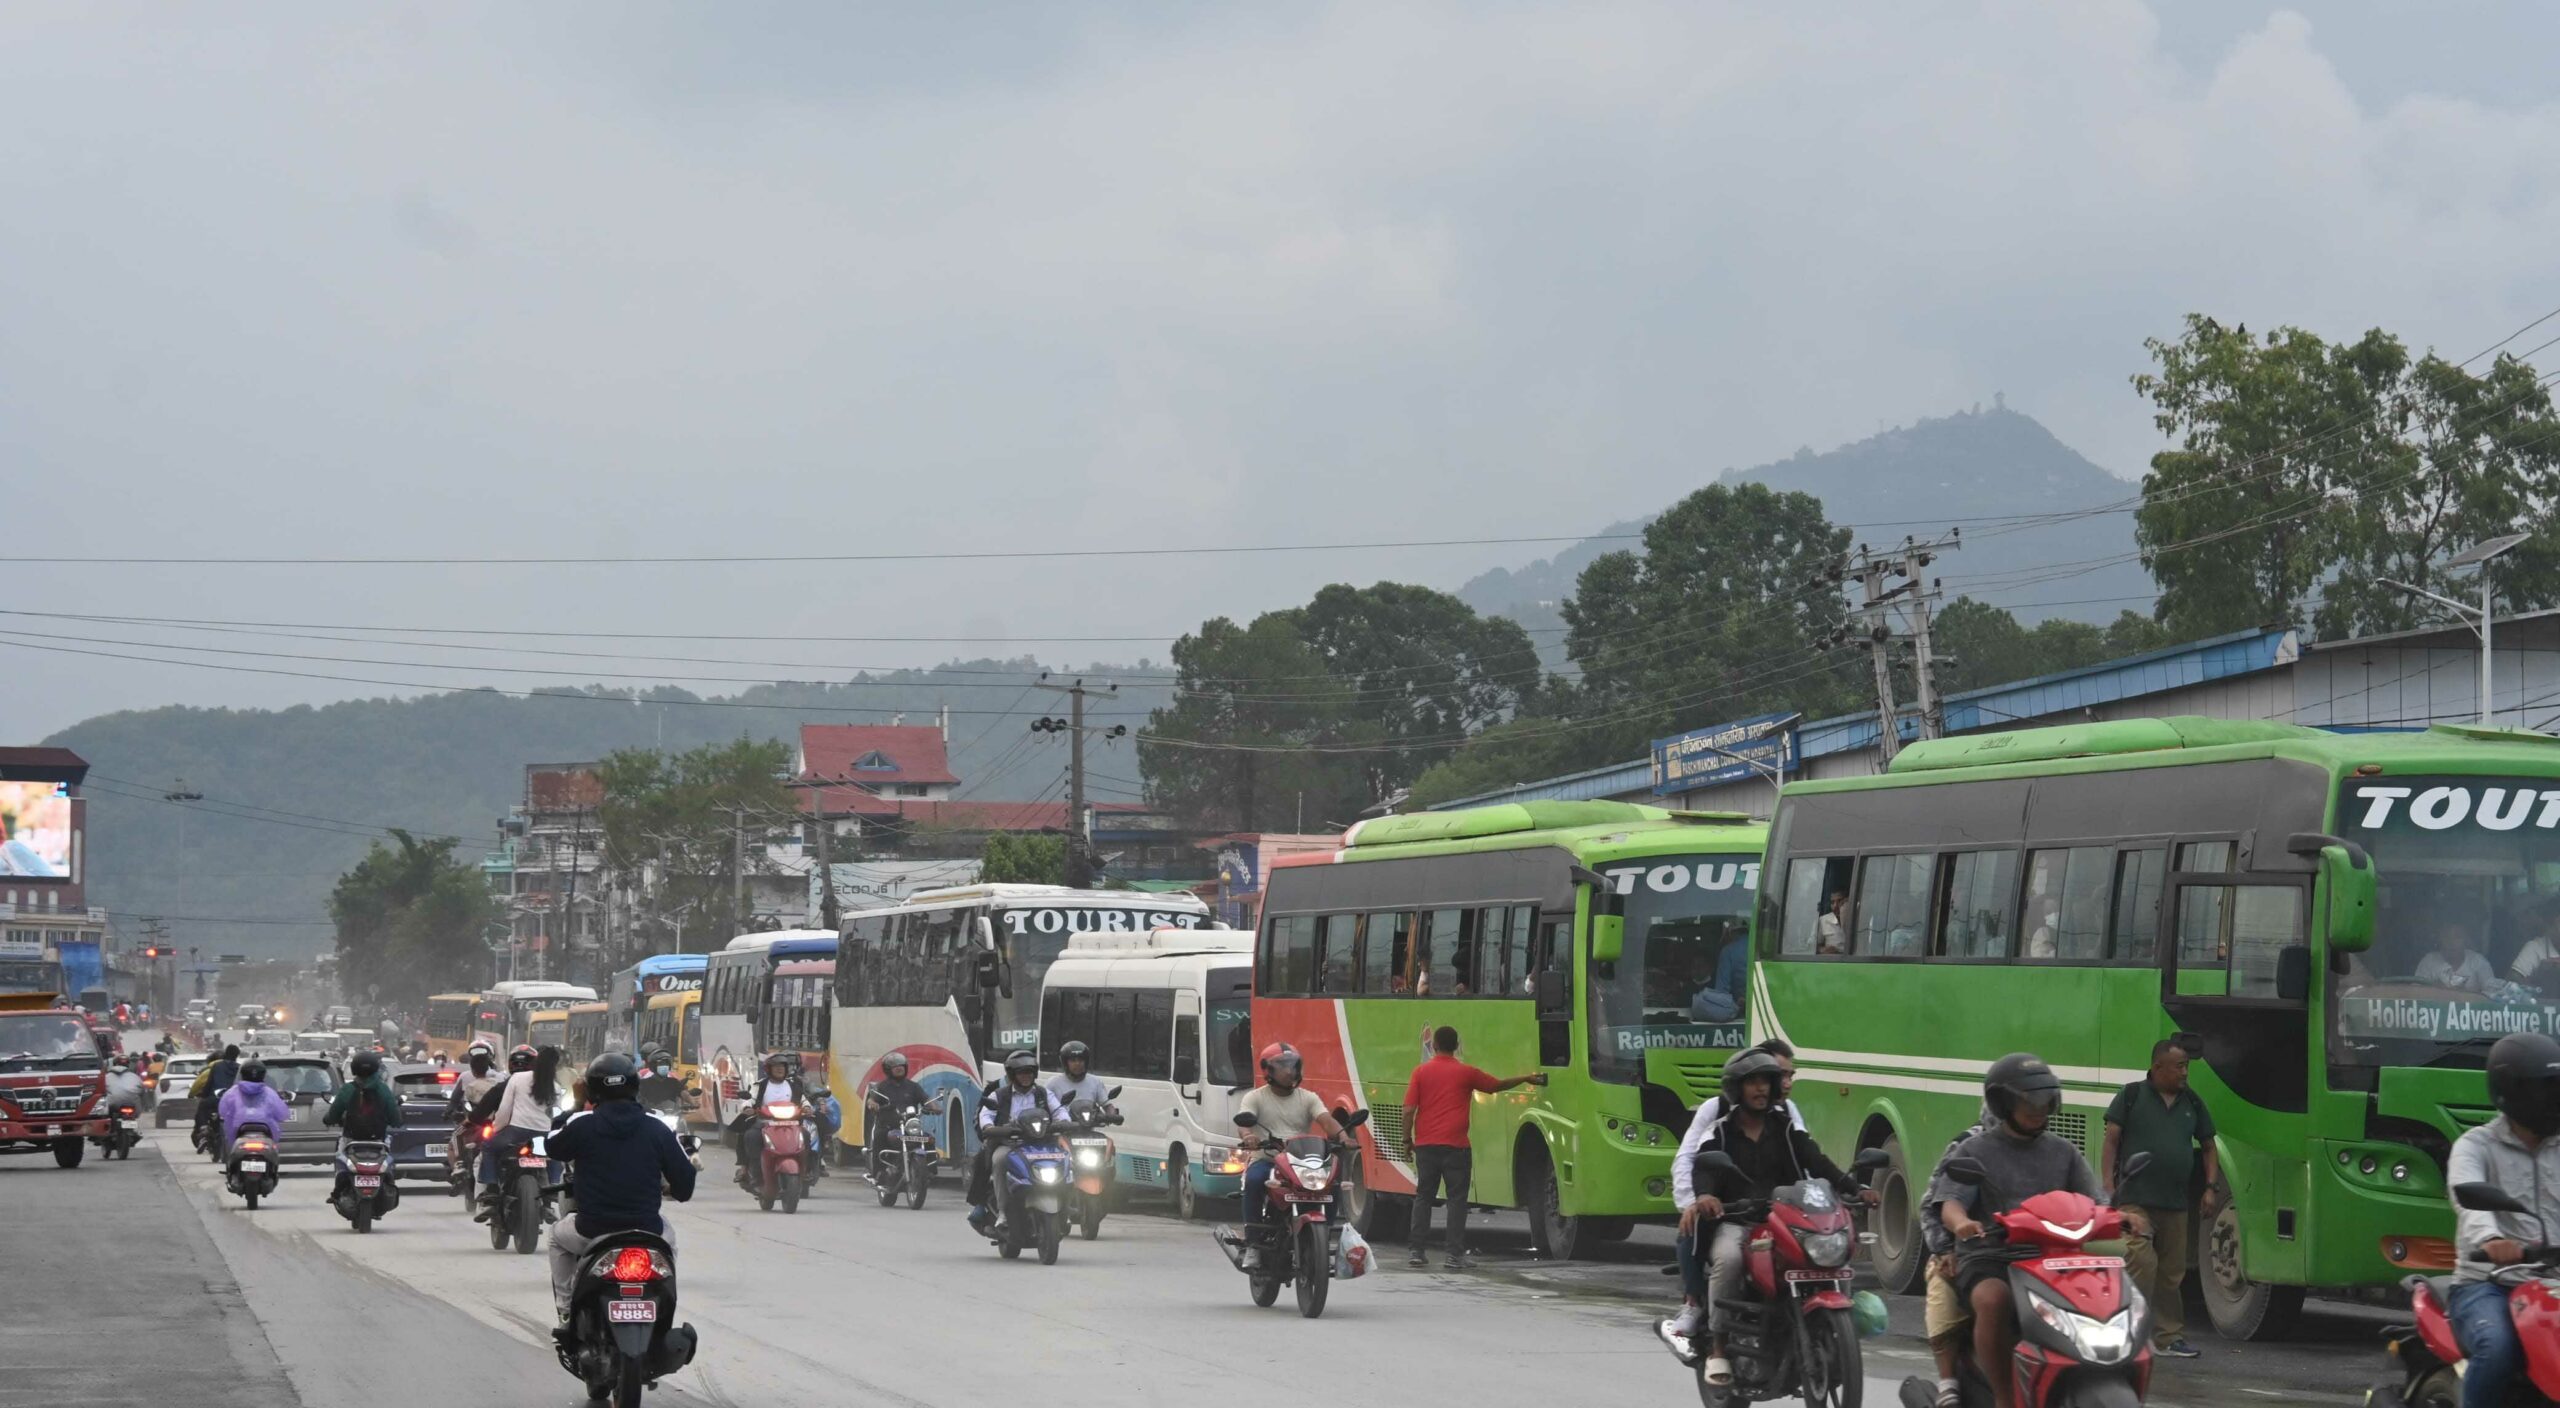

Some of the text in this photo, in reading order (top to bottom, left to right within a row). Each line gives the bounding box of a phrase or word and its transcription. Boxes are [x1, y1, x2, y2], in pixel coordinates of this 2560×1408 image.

[815, 885, 870, 895] JECOO
[1003, 909, 1200, 934] TOURIST
[660, 975, 702, 991] One
[2368, 999, 2440, 1037] Holiday
[2446, 1001, 2540, 1034] Adventure
[1617, 1029, 1706, 1051] Rainbow
